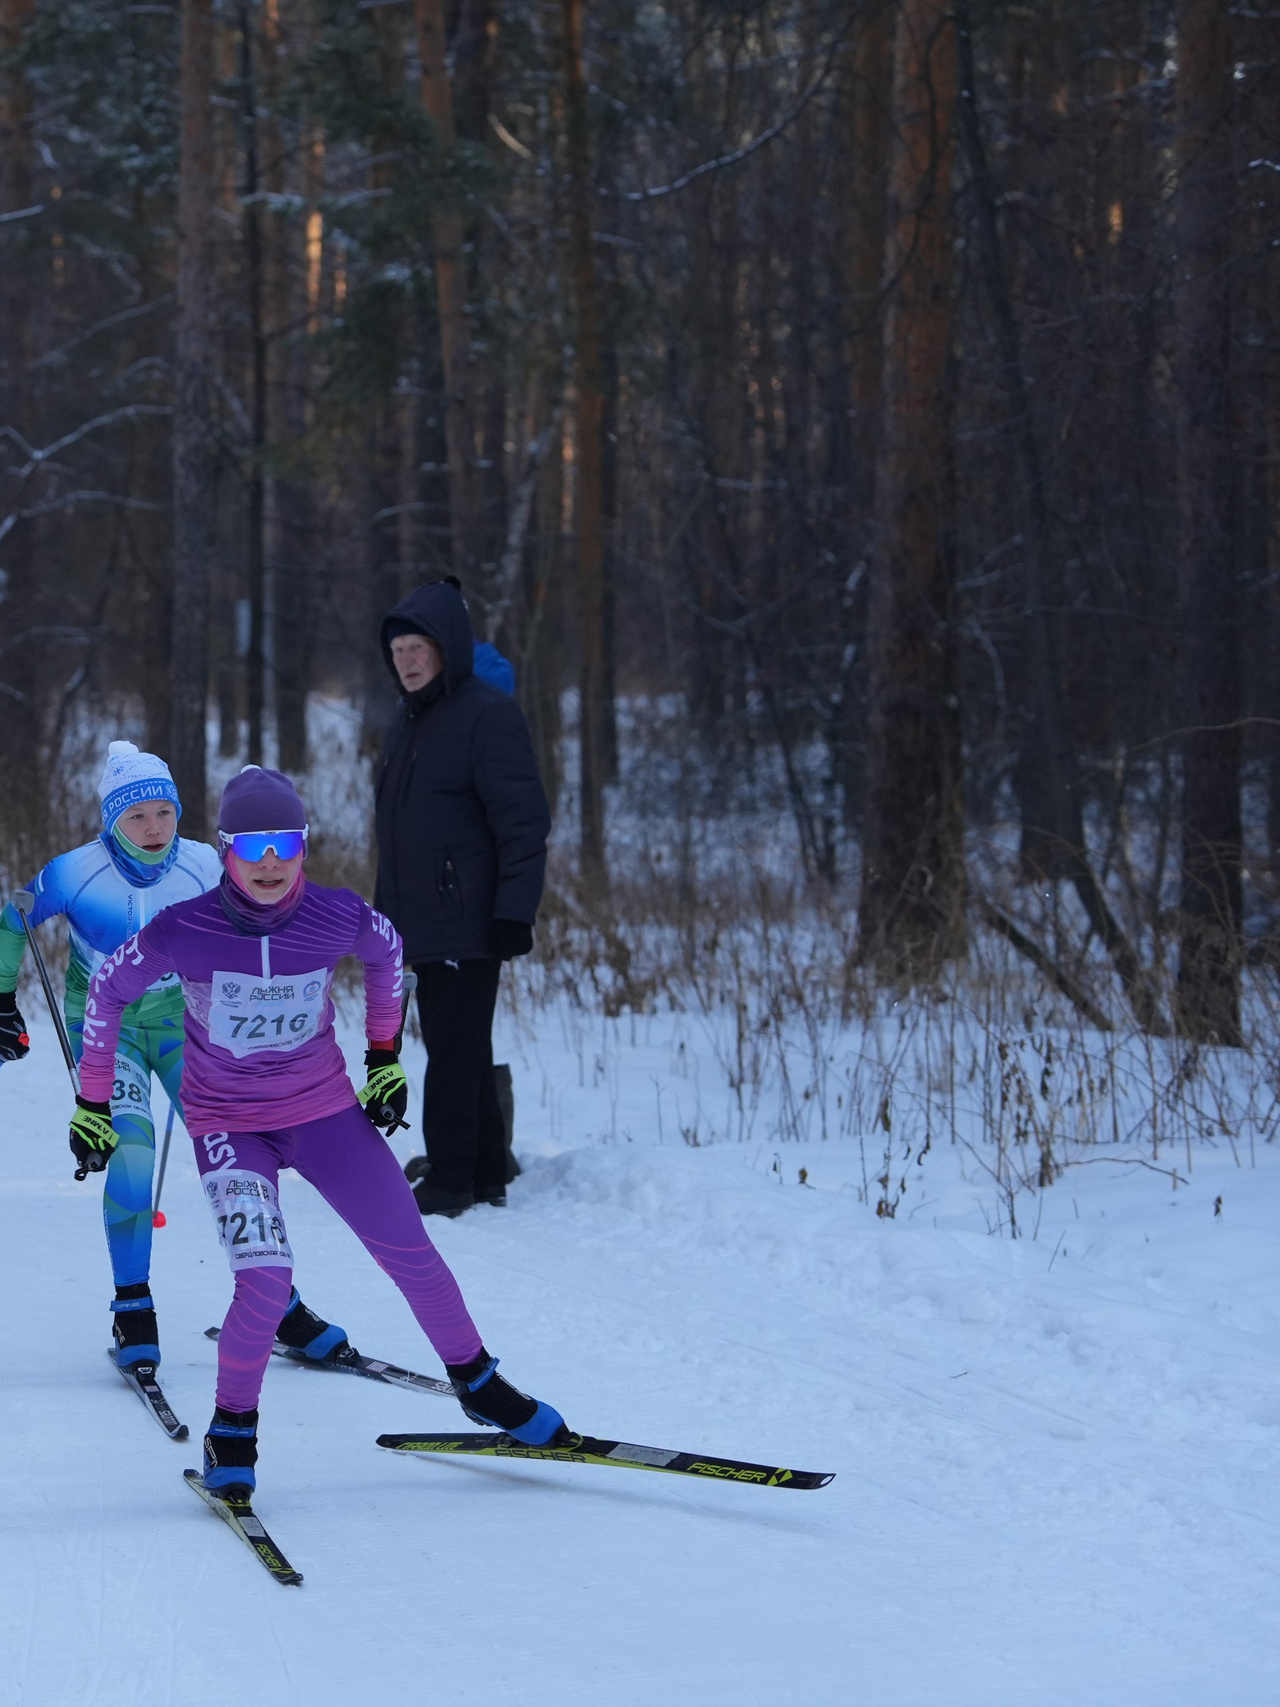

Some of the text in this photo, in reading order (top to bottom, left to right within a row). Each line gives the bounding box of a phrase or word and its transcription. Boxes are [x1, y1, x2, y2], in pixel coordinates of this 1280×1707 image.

[108, 785, 163, 812] РОССИИ
[229, 1013, 309, 1039] 7216
[111, 1079, 142, 1102] 38
[218, 1211, 286, 1245] 7216
[494, 1448, 587, 1463] FISCHER
[686, 1462, 768, 1482] FISCHER
